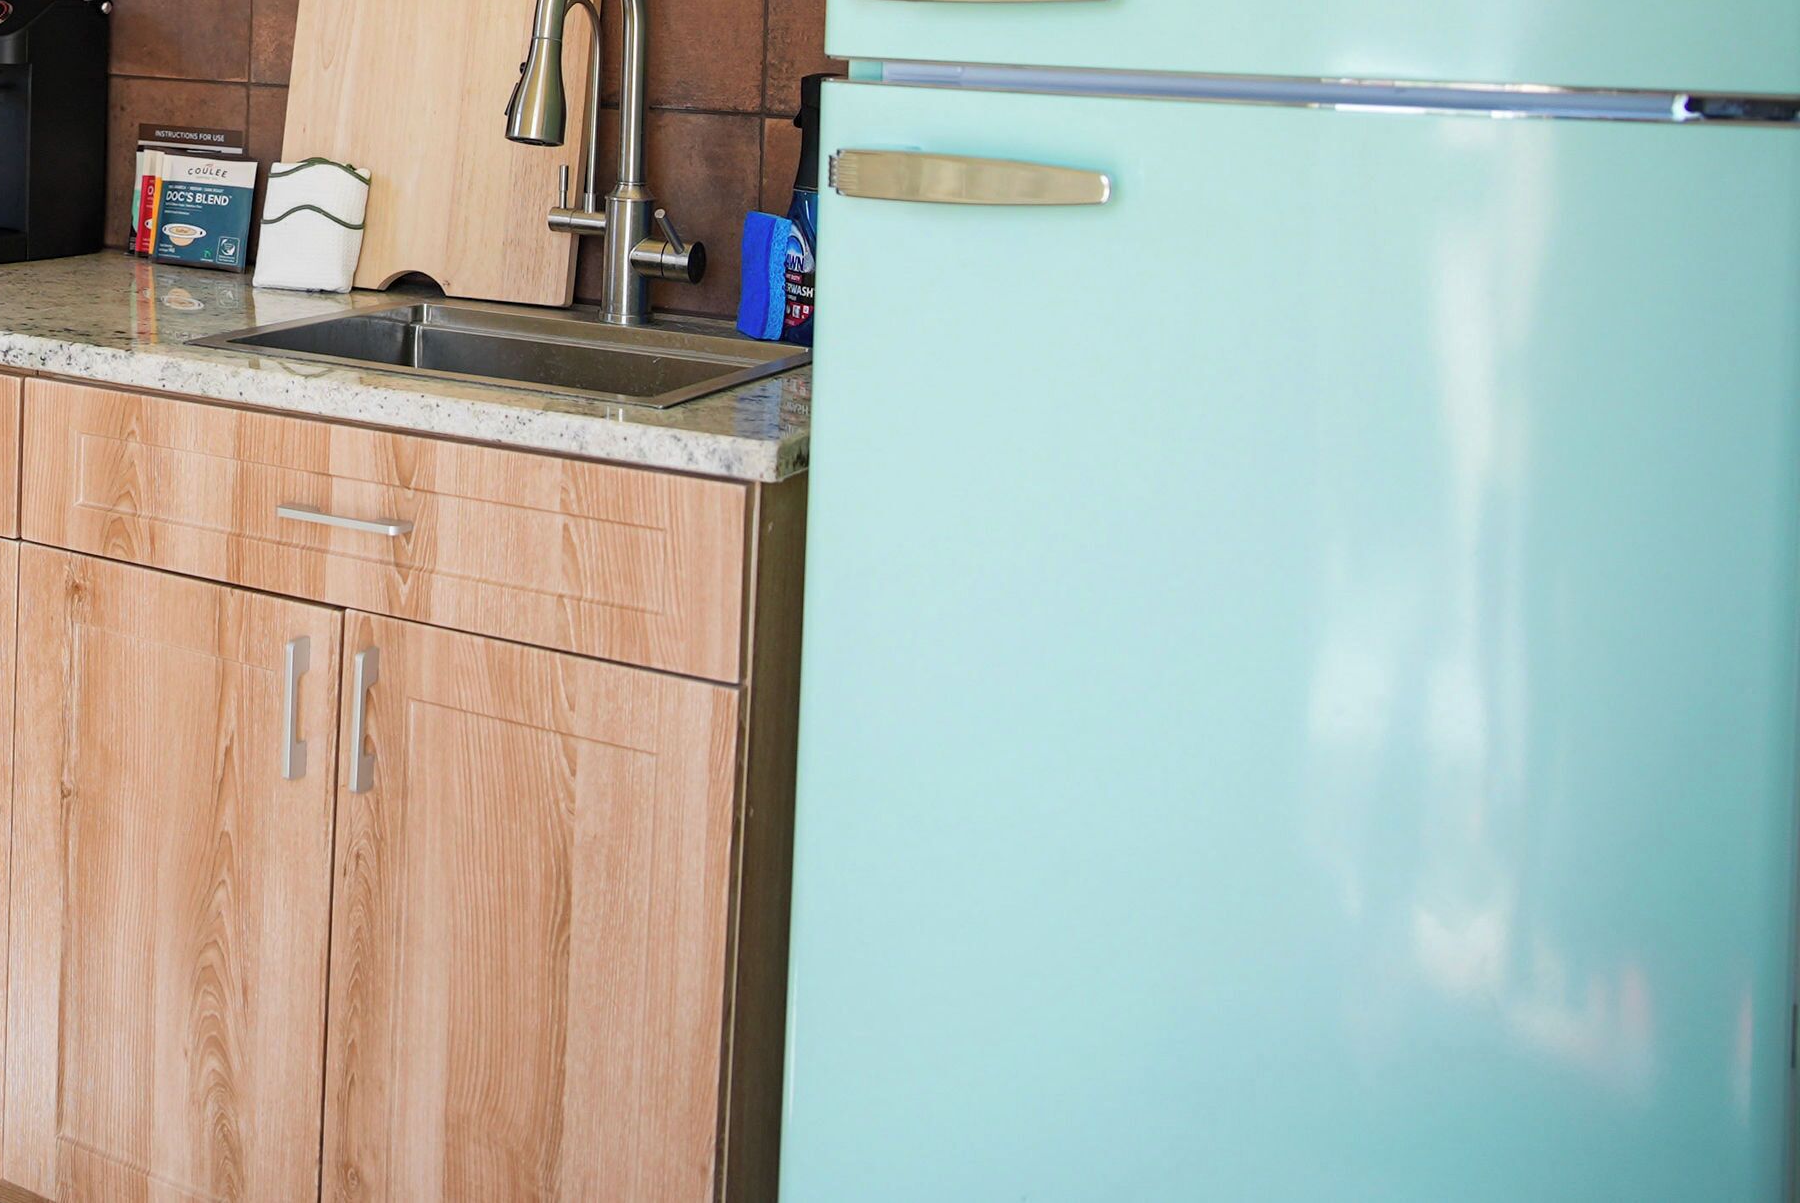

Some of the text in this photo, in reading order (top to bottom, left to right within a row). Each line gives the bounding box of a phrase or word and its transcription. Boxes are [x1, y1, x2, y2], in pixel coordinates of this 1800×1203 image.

[155, 130, 224, 142] INSTRUCTIONS FOR USE
[166, 190, 194, 202] DOC'S
[195, 193, 229, 206] BLEND
[786, 254, 804, 272] AWN
